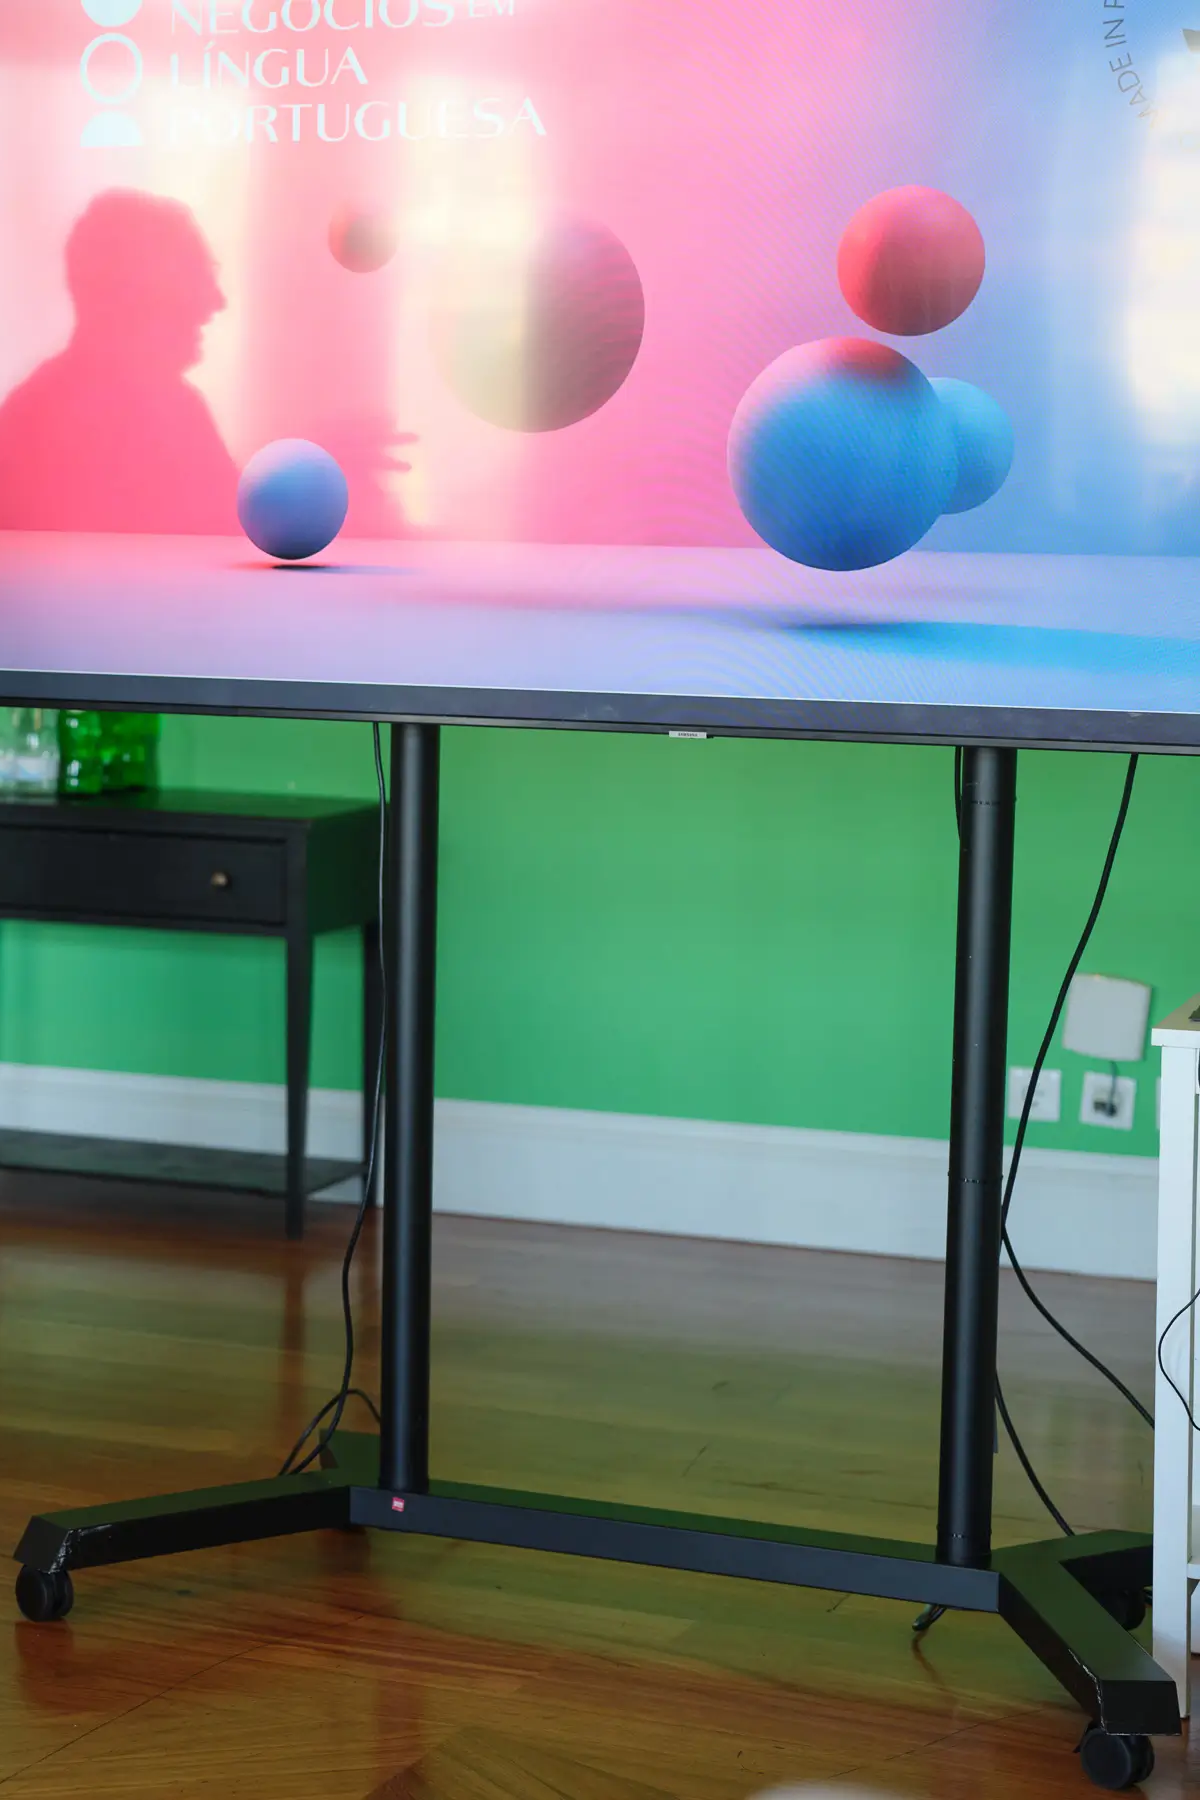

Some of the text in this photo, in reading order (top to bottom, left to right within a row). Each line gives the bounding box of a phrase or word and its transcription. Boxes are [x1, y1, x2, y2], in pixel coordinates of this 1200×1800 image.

[1102, 18, 1127, 48] IN
[169, 40, 369, 89] LÍNGUA
[168, 96, 547, 144] PORTUGUESA
